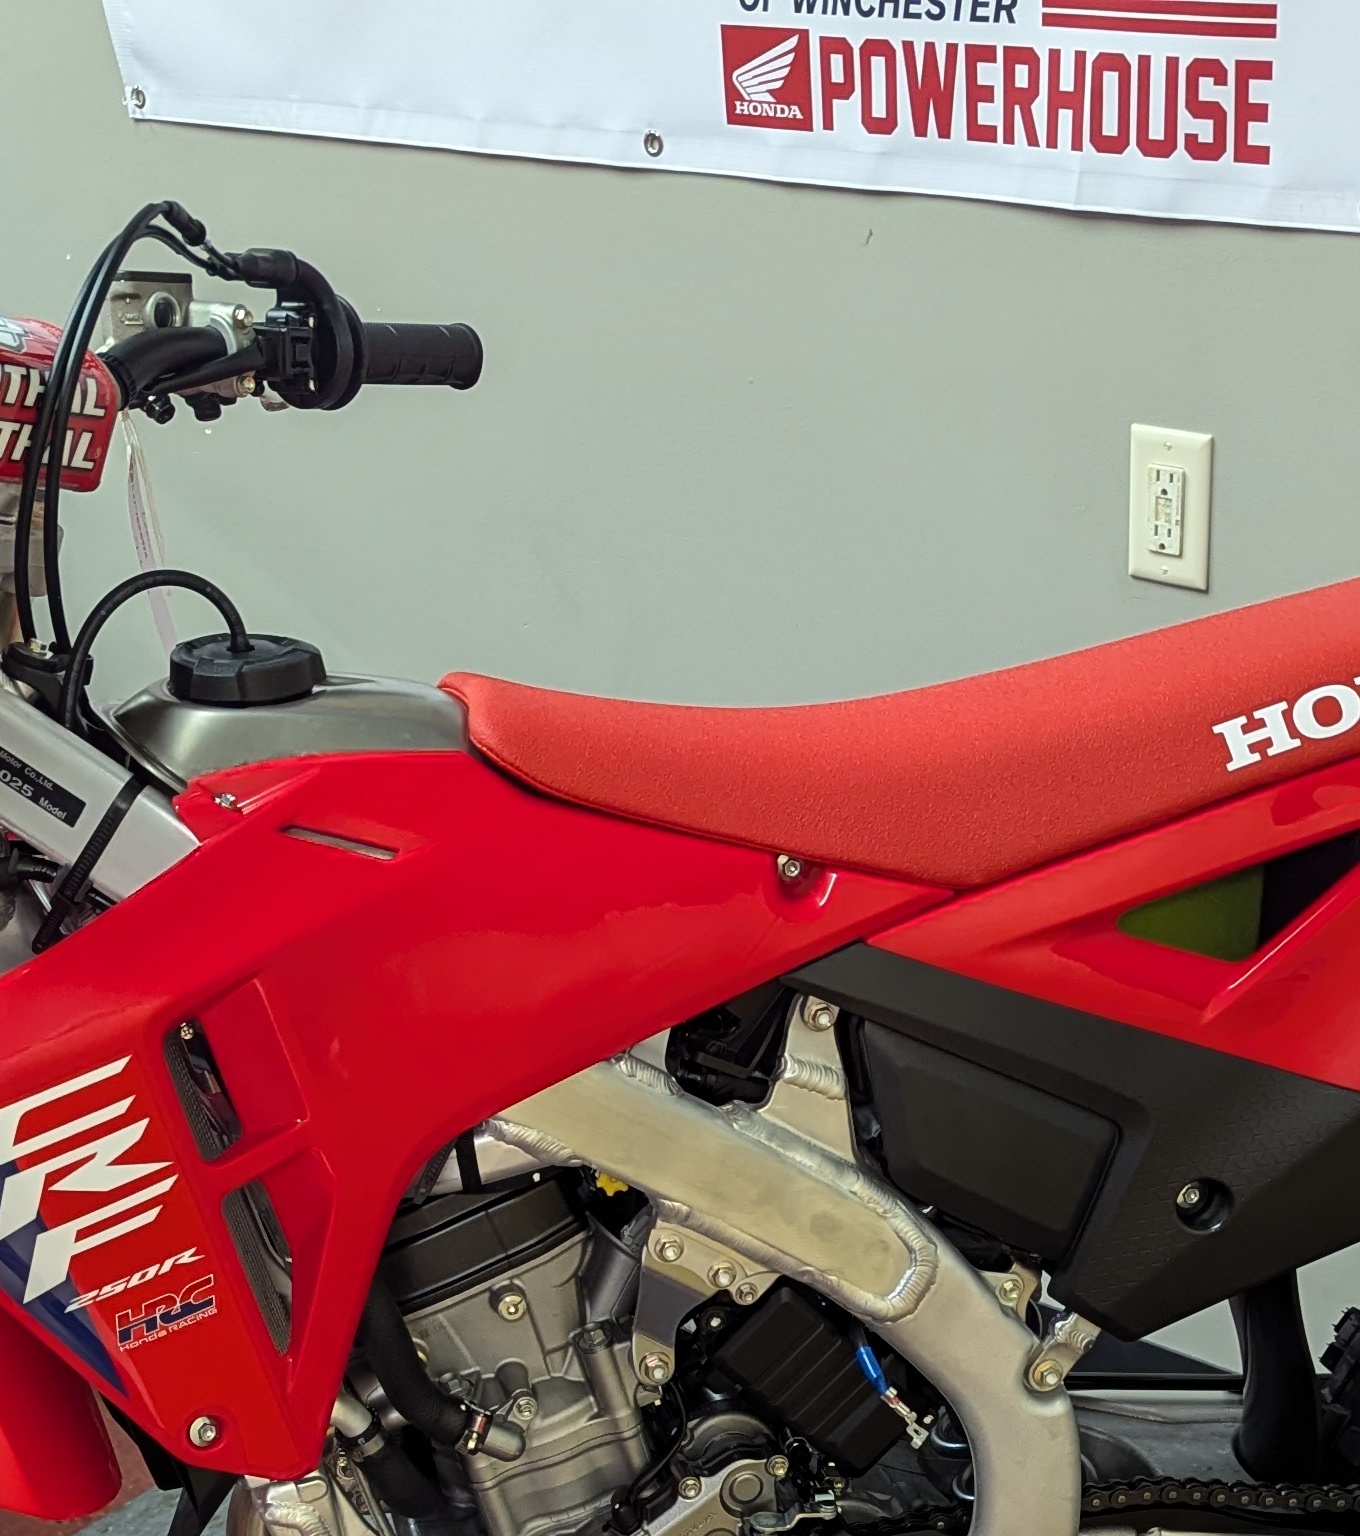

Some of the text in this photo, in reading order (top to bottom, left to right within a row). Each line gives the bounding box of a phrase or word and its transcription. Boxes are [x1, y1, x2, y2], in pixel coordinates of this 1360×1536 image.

[734, 101, 804, 119] HONDA
[819, 36, 1273, 165] POWERHOUSE
[38, 796, 68, 821] Model
[64, 1246, 206, 1314] 250R
[115, 1273, 216, 1347] HRC
[119, 1308, 218, 1352] Honda RACING
